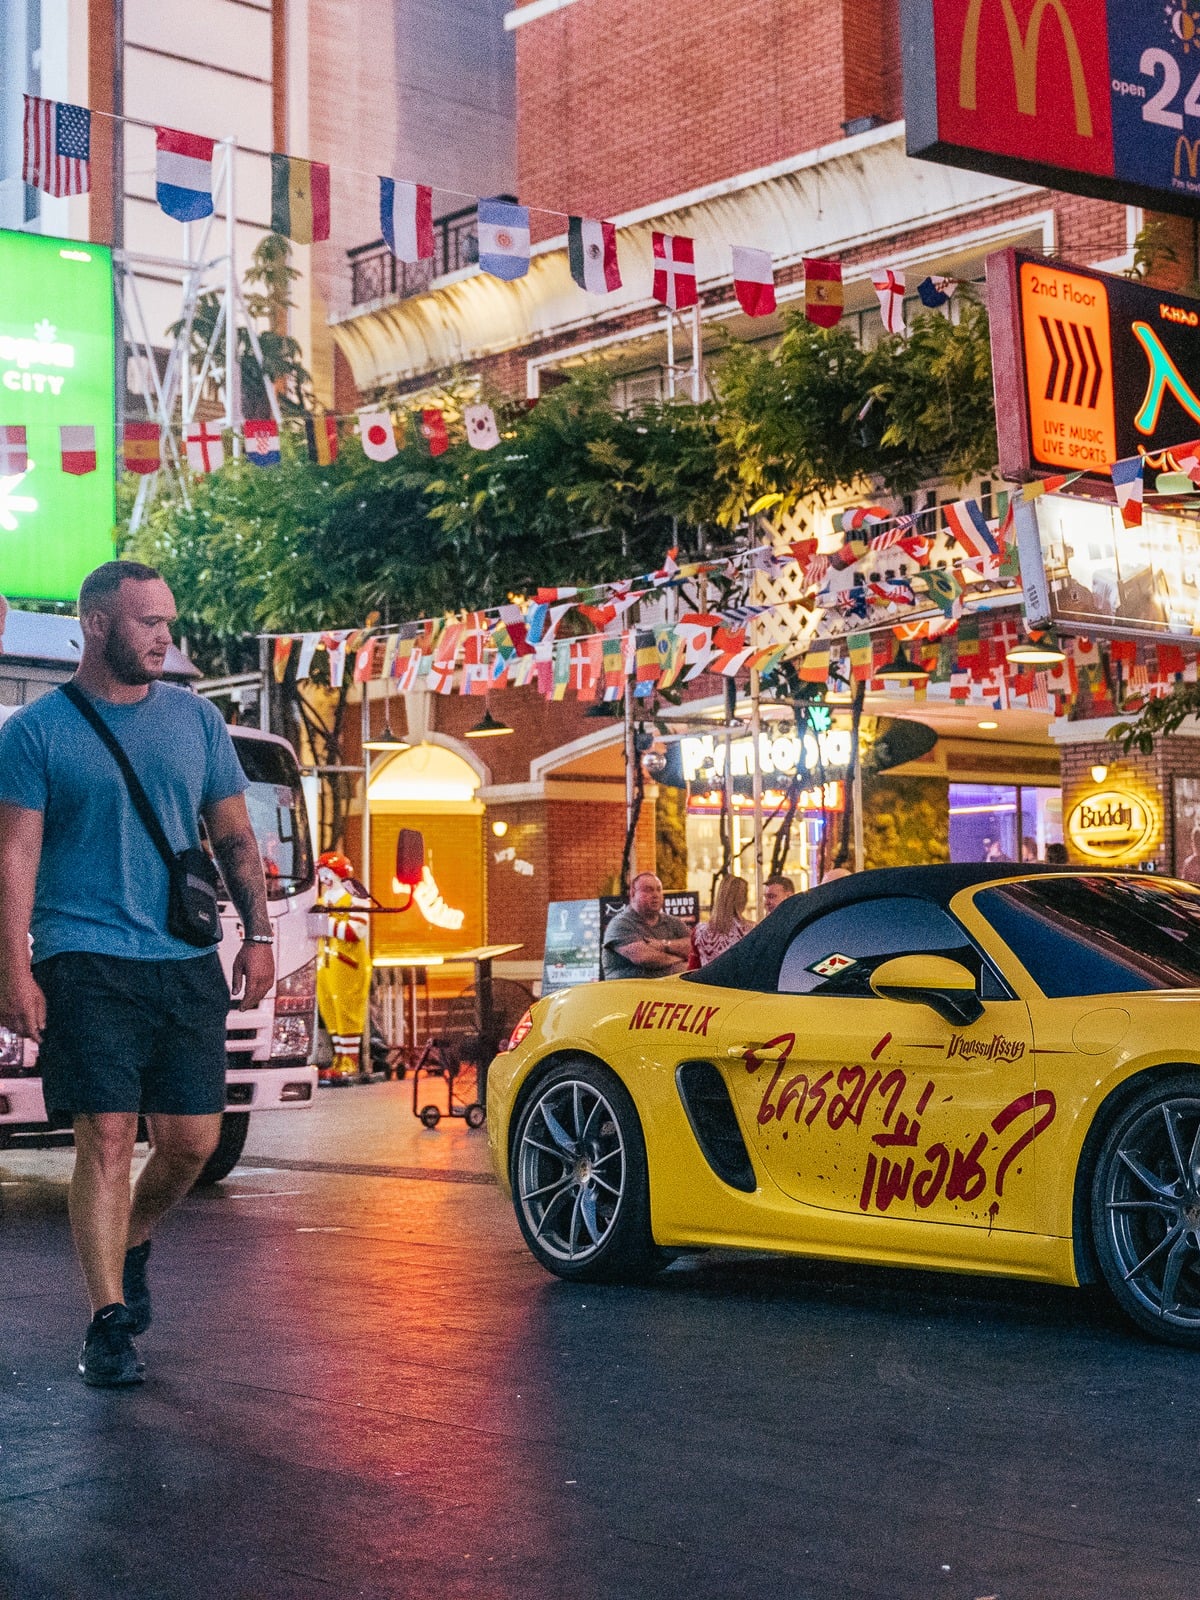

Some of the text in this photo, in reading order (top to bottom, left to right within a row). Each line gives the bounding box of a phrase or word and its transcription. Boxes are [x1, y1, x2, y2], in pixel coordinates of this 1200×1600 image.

[1112, 79, 1146, 98] open
[1031, 277, 1097, 307] 2nd Floor
[1159, 303, 1199, 327] KHAO
[2, 370, 65, 395] CITY
[1044, 420, 1103, 444] LIVE MUSIC
[1043, 439, 1107, 464] LIVE SPORTS
[1080, 802, 1132, 831] Buddy
[628, 1000, 720, 1037] NETFLIX
